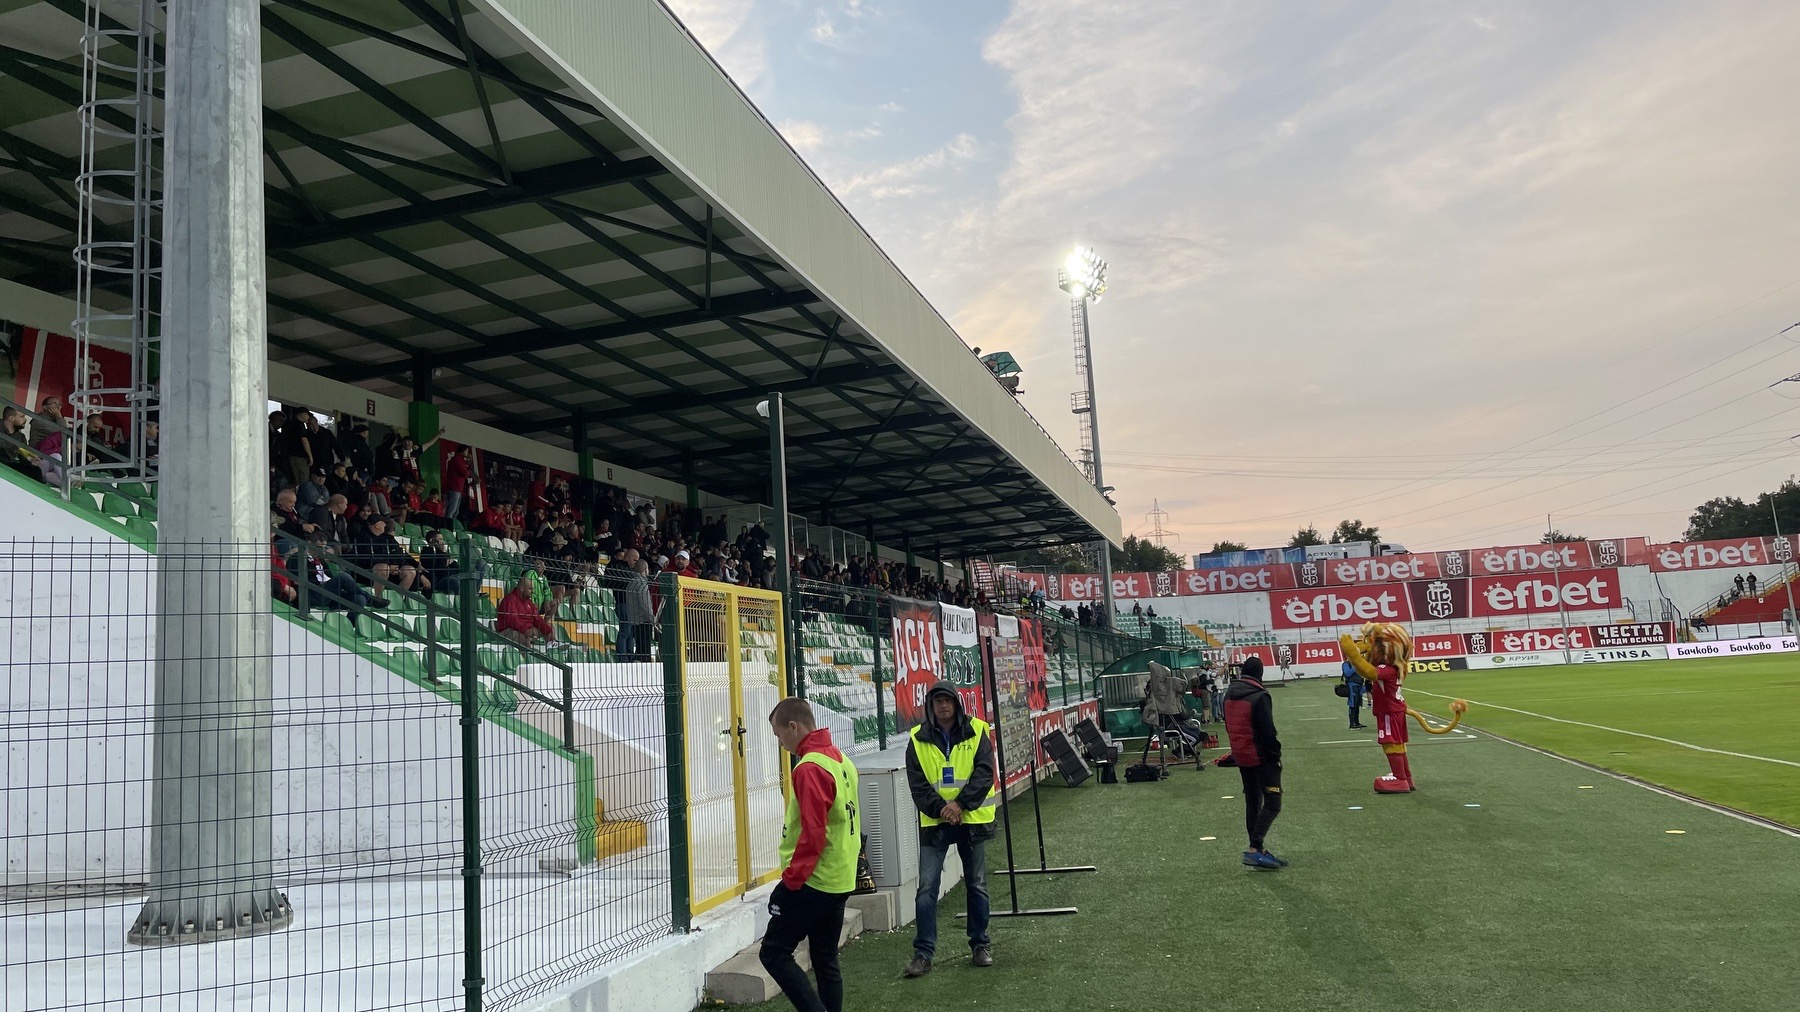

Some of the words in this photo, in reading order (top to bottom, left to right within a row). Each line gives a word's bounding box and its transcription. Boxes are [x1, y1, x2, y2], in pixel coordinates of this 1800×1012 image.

[1483, 545, 1578, 573] efbet
[1659, 541, 1759, 569] efbet
[1188, 567, 1272, 593] efbet
[1337, 556, 1426, 583] efbet
[1070, 575, 1139, 598] efet
[1488, 576, 1610, 611] efbet
[1286, 590, 1399, 623] efbet
[1504, 629, 1584, 652] efbet
[1597, 623, 1664, 640] ЧЕСТТА
[1599, 637, 1628, 647] ПРЕДИ
[1629, 635, 1664, 644] ВСИЧКО
[893, 617, 942, 686] ЦСКА
[1305, 648, 1334, 658] 1948
[1422, 641, 1452, 651] 1948
[1598, 650, 1652, 660] TINSA
[1677, 645, 1719, 656] Бачково
[1729, 641, 1772, 652] Бачково
[1407, 660, 1451, 673] fbet
